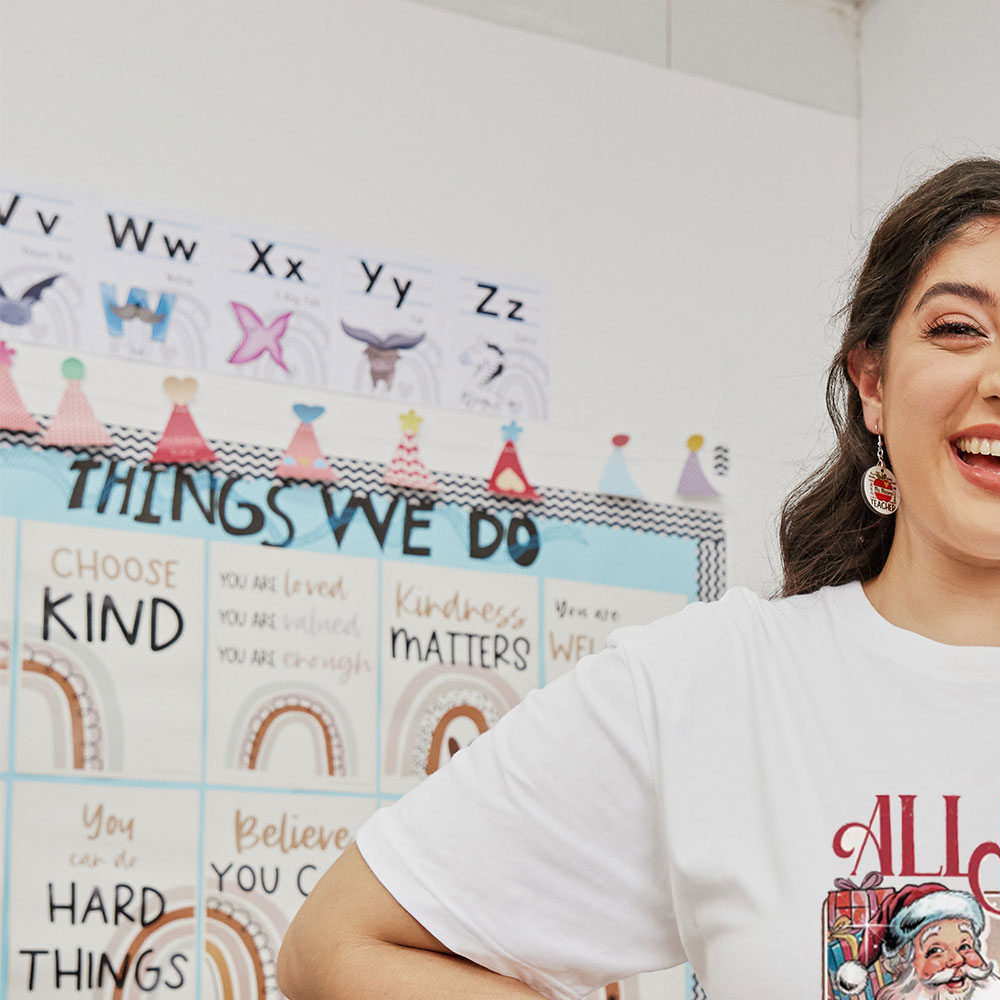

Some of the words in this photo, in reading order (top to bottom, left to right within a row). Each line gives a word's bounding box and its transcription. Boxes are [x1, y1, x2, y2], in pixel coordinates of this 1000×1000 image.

[67, 459, 294, 548] THINGS
[321, 484, 435, 557] WE
[469, 506, 541, 567] DO
[51, 548, 179, 590] CHOOSE
[219, 572, 247, 591] YOU
[253, 574, 276, 593] ARE
[284, 569, 346, 600] loved
[42, 586, 184, 652] KIND
[218, 609, 247, 627] YOU
[252, 611, 275, 630] ARE
[395, 582, 527, 631] Kindness
[218, 646, 247, 665] YOU
[251, 649, 275, 668] ARE
[282, 651, 371, 686] enough
[82, 803, 134, 840] You
[234, 809, 350, 854] Believe
[211, 862, 280, 895] YOU
[49, 881, 166, 927] HARD
[20, 947, 189, 992] THINGS
